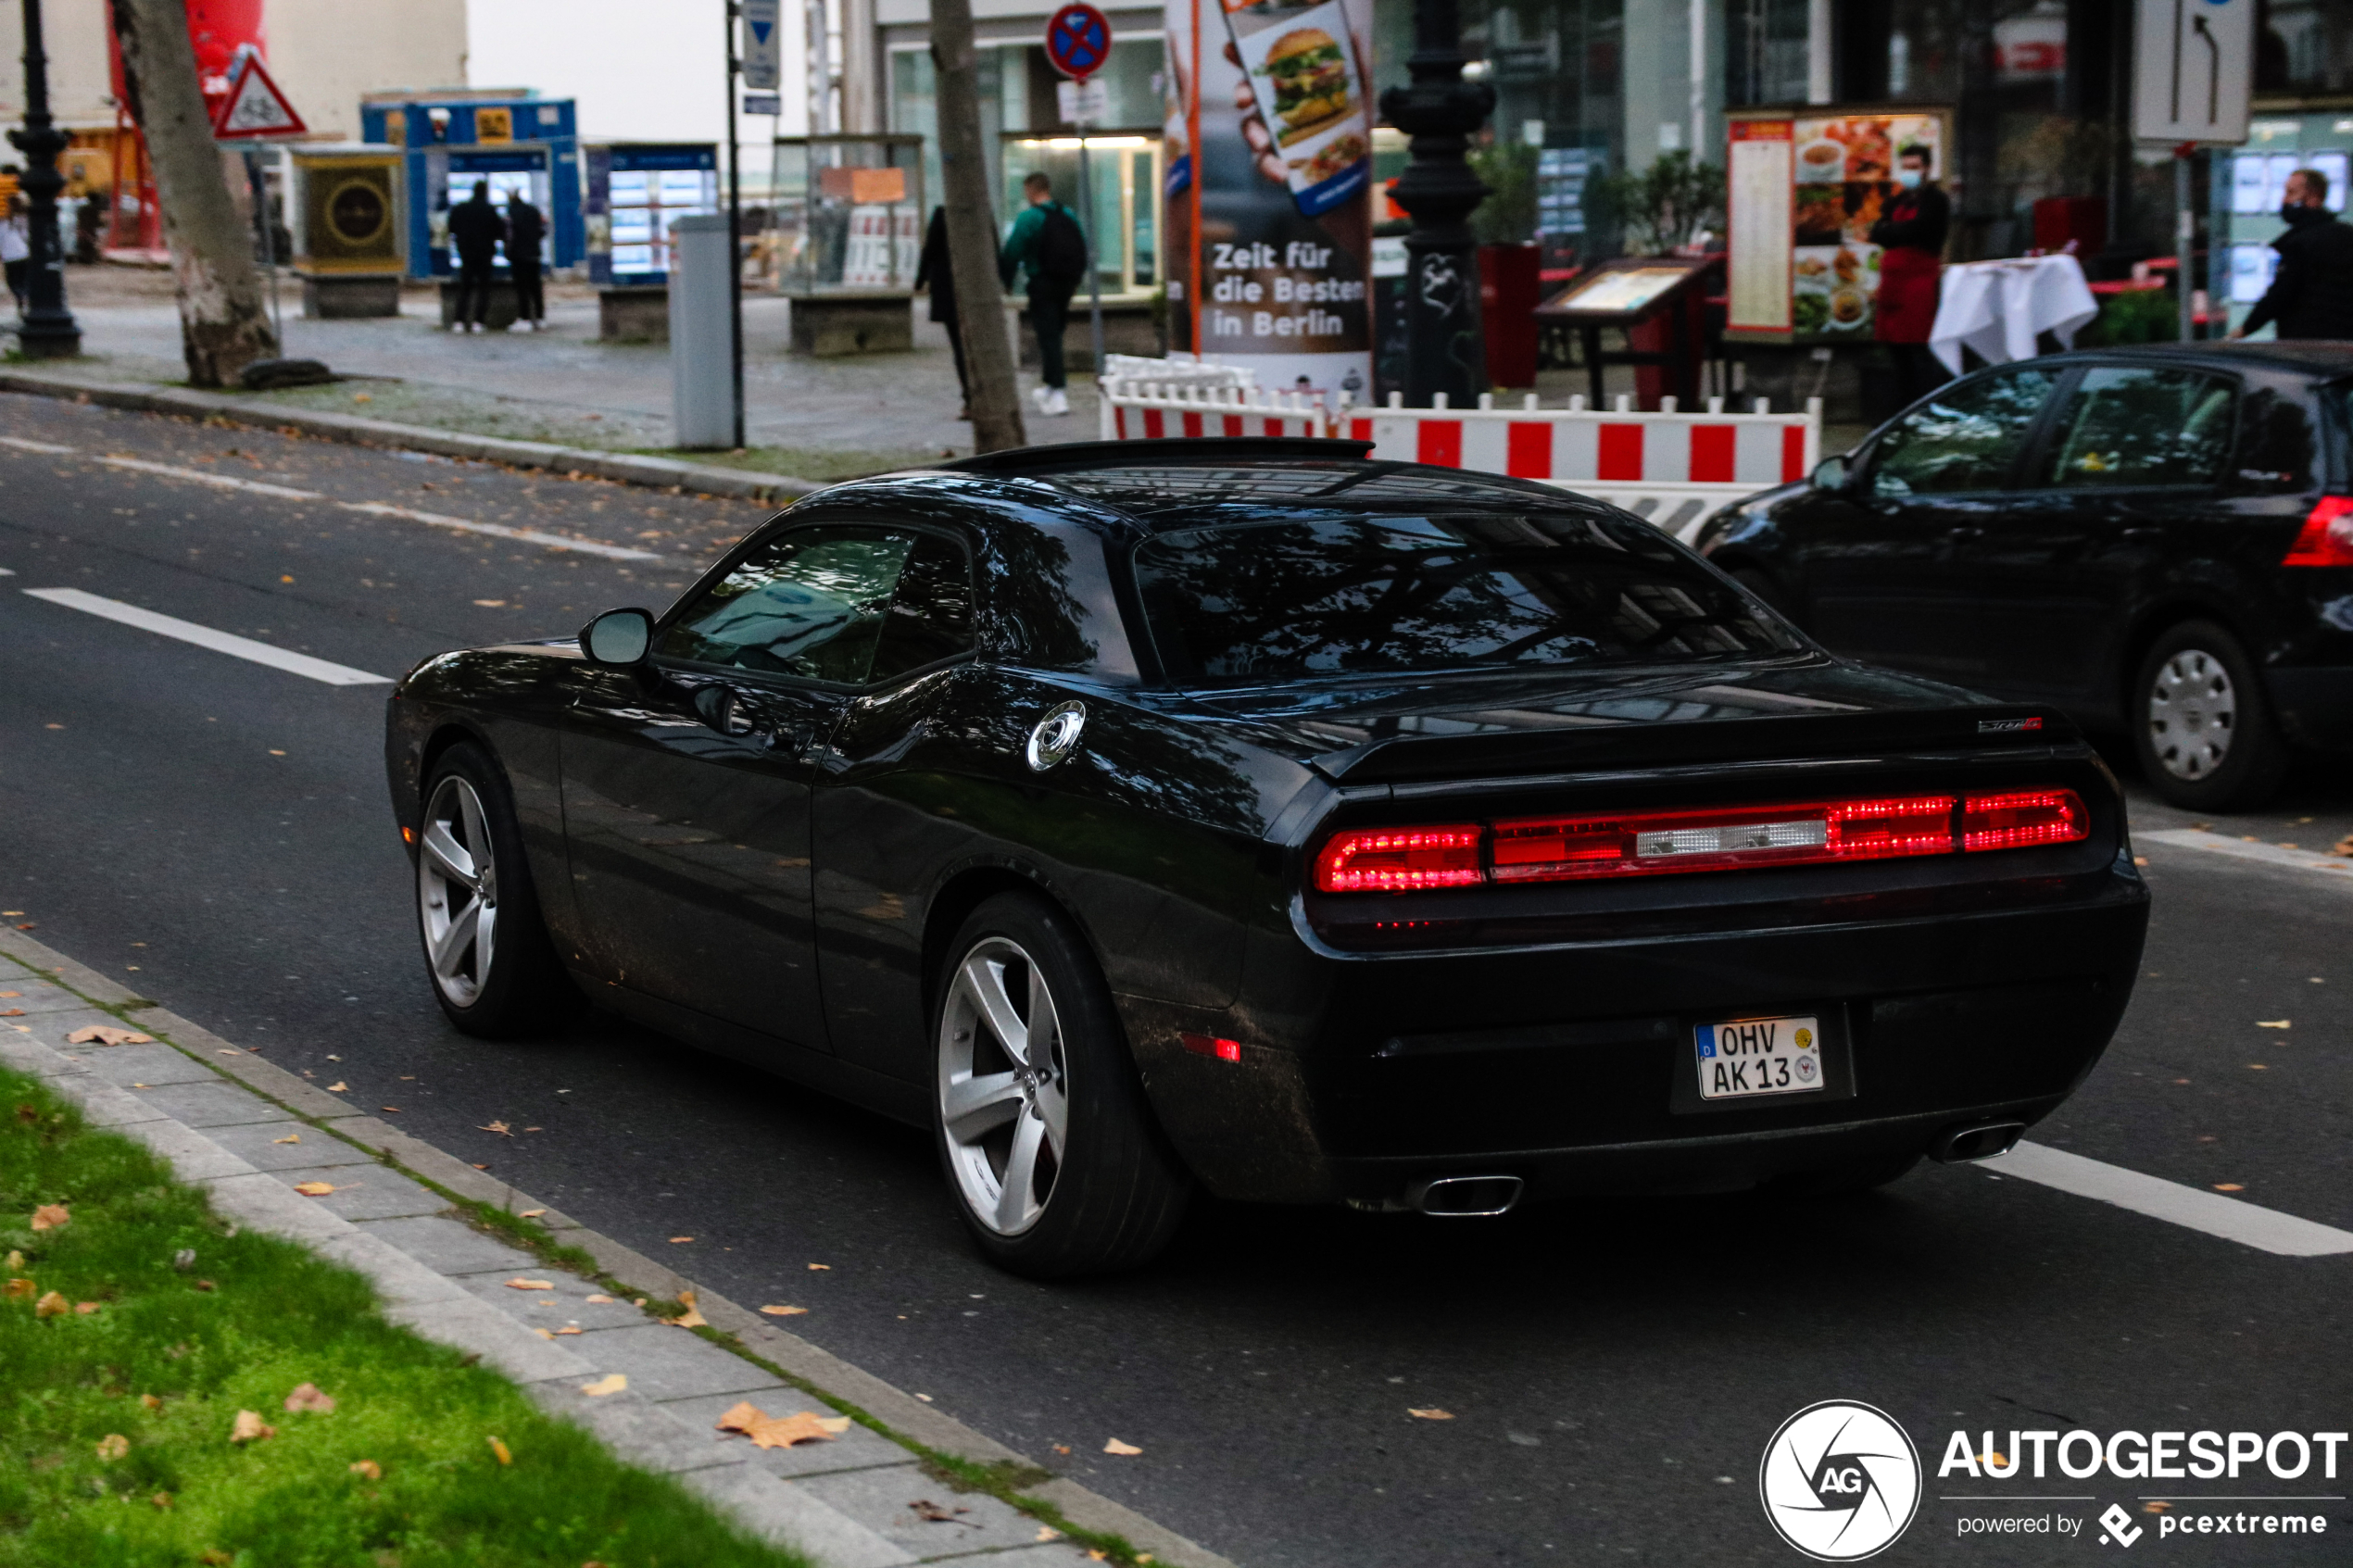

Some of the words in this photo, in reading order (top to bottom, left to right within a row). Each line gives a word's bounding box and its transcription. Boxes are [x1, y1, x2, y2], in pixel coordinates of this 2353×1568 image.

[1213, 241, 1277, 270] Zeit
[1286, 241, 1332, 269] für
[1213, 275, 1263, 303] die
[1274, 277, 1365, 303] Besten
[1214, 308, 1242, 336] in
[1252, 308, 1343, 336] Berlin
[1703, 1046, 1711, 1056] D
[1721, 1023, 1775, 1056] OHV
[1714, 1060, 1750, 1093] AK
[1755, 1058, 1791, 1088] 13
